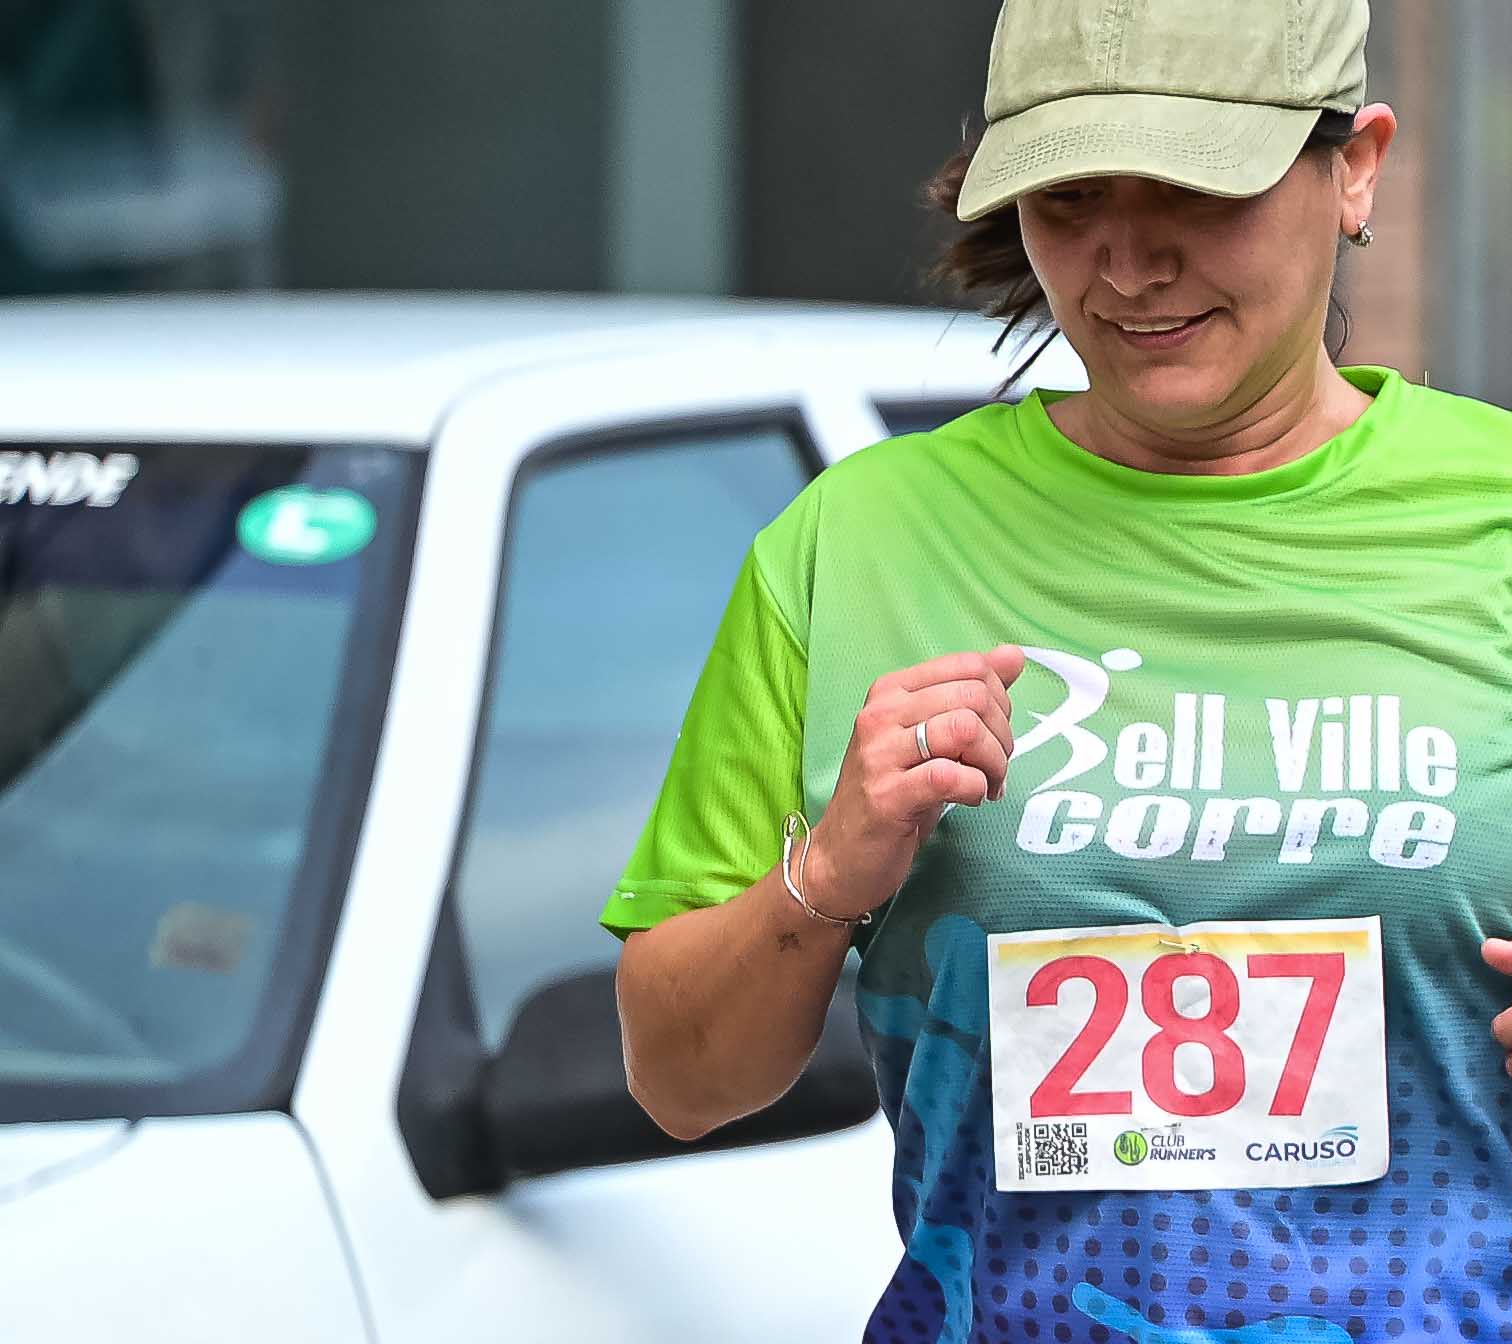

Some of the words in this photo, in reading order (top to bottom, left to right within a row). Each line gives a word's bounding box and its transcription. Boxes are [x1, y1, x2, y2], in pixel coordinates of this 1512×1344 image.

[1264, 693, 1459, 799] Ville
[1015, 789, 1457, 869] corre
[1025, 952, 1346, 1119] 287
[1149, 1147, 1217, 1162] RUNNER'S
[1151, 1134, 1185, 1148] CLUB
[1245, 1138, 1356, 1162] CARUSO
